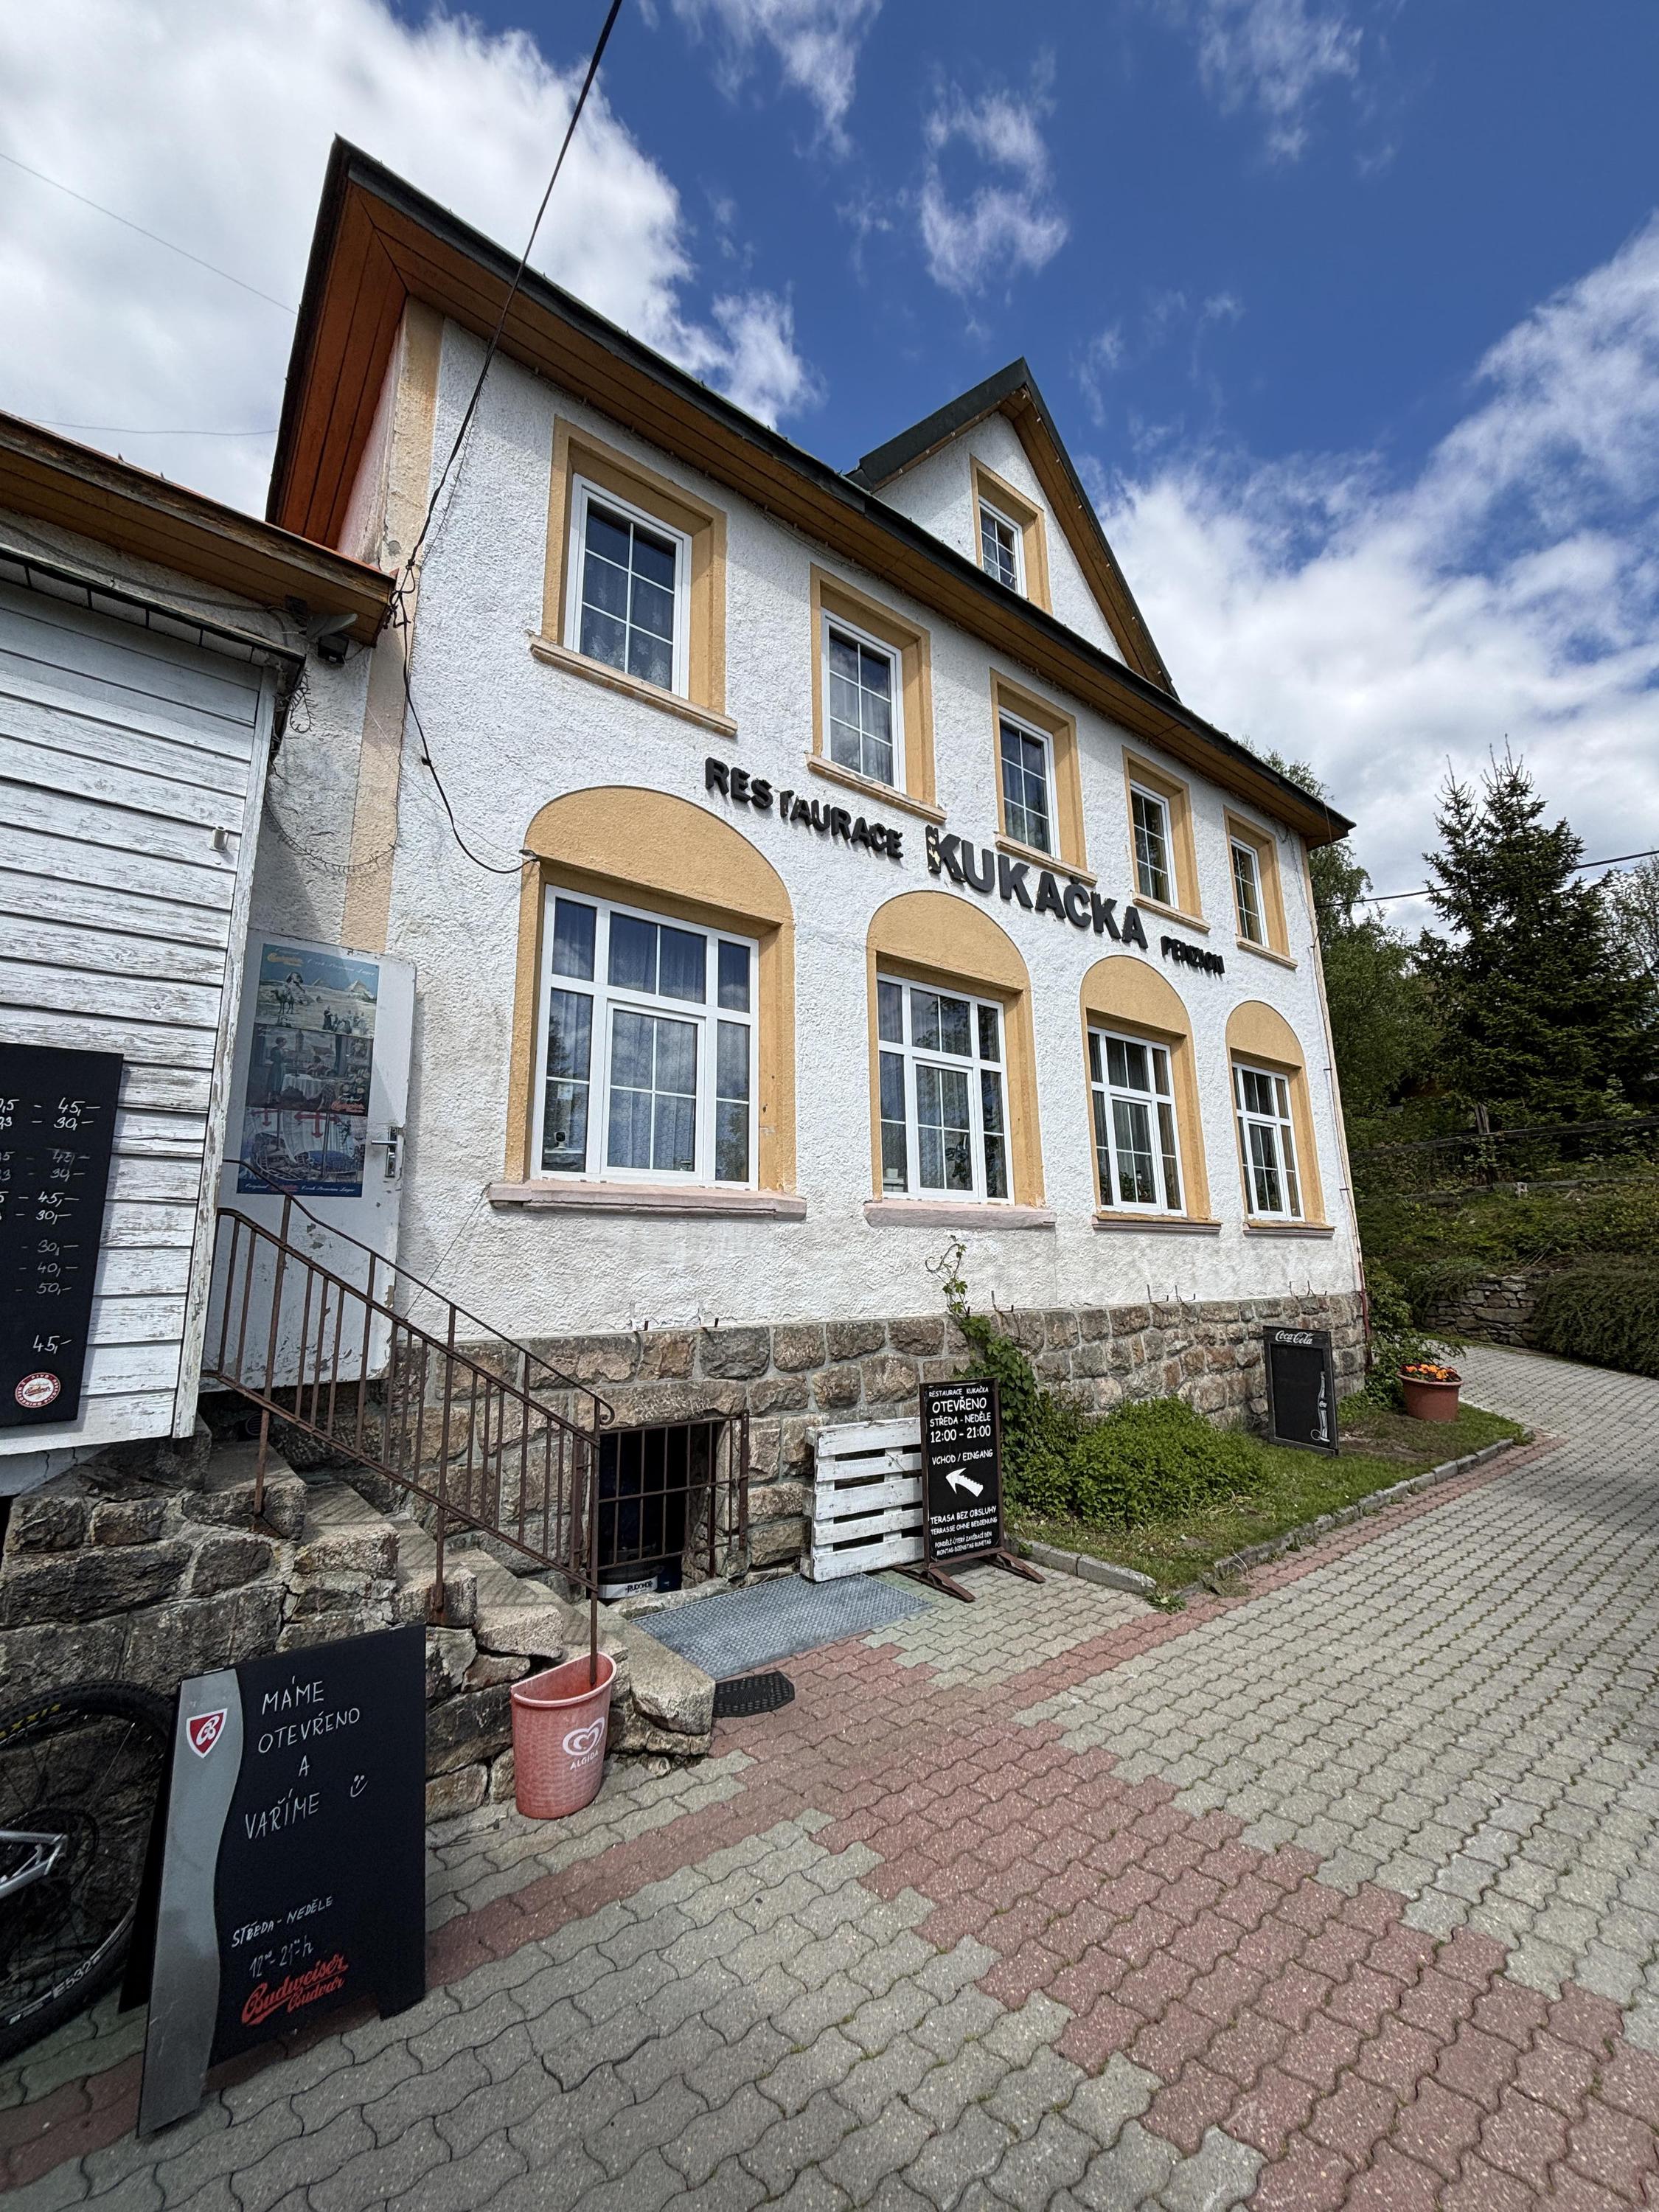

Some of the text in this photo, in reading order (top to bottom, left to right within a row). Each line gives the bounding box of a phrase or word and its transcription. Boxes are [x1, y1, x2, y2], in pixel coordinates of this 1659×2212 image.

[705, 757, 904, 859] RESTAURACE
[925, 824, 1149, 950] KUKAČKA
[1275, 1329, 1315, 1346] Coca-Cola
[929, 1385, 989, 1398] RESTAURACE KUKAČKA
[932, 1396, 987, 1414] OTEVŘENO
[929, 1415, 959, 1427] STŘEDA
[964, 1411, 992, 1424] NEDĚLE
[931, 1428, 957, 1444] 12:00
[967, 1425, 991, 1439] 21:00
[931, 1454, 956, 1466] VCHOD
[962, 1449, 993, 1461] EINGANG
[931, 1505, 997, 1525] TERASA BEZ OBSLUHY
[931, 1524, 956, 1535] TERRASSE
[956, 1522, 970, 1530] OHNE
[262, 1675, 324, 1716] MÁME
[298, 1755, 310, 1778] A
[570, 1749, 599, 1770] ALGIDA
[246, 1788, 320, 1840] VAŘÍME
[241, 1953, 349, 2025] Budweiser
[287, 1976, 346, 2013] Budvar
